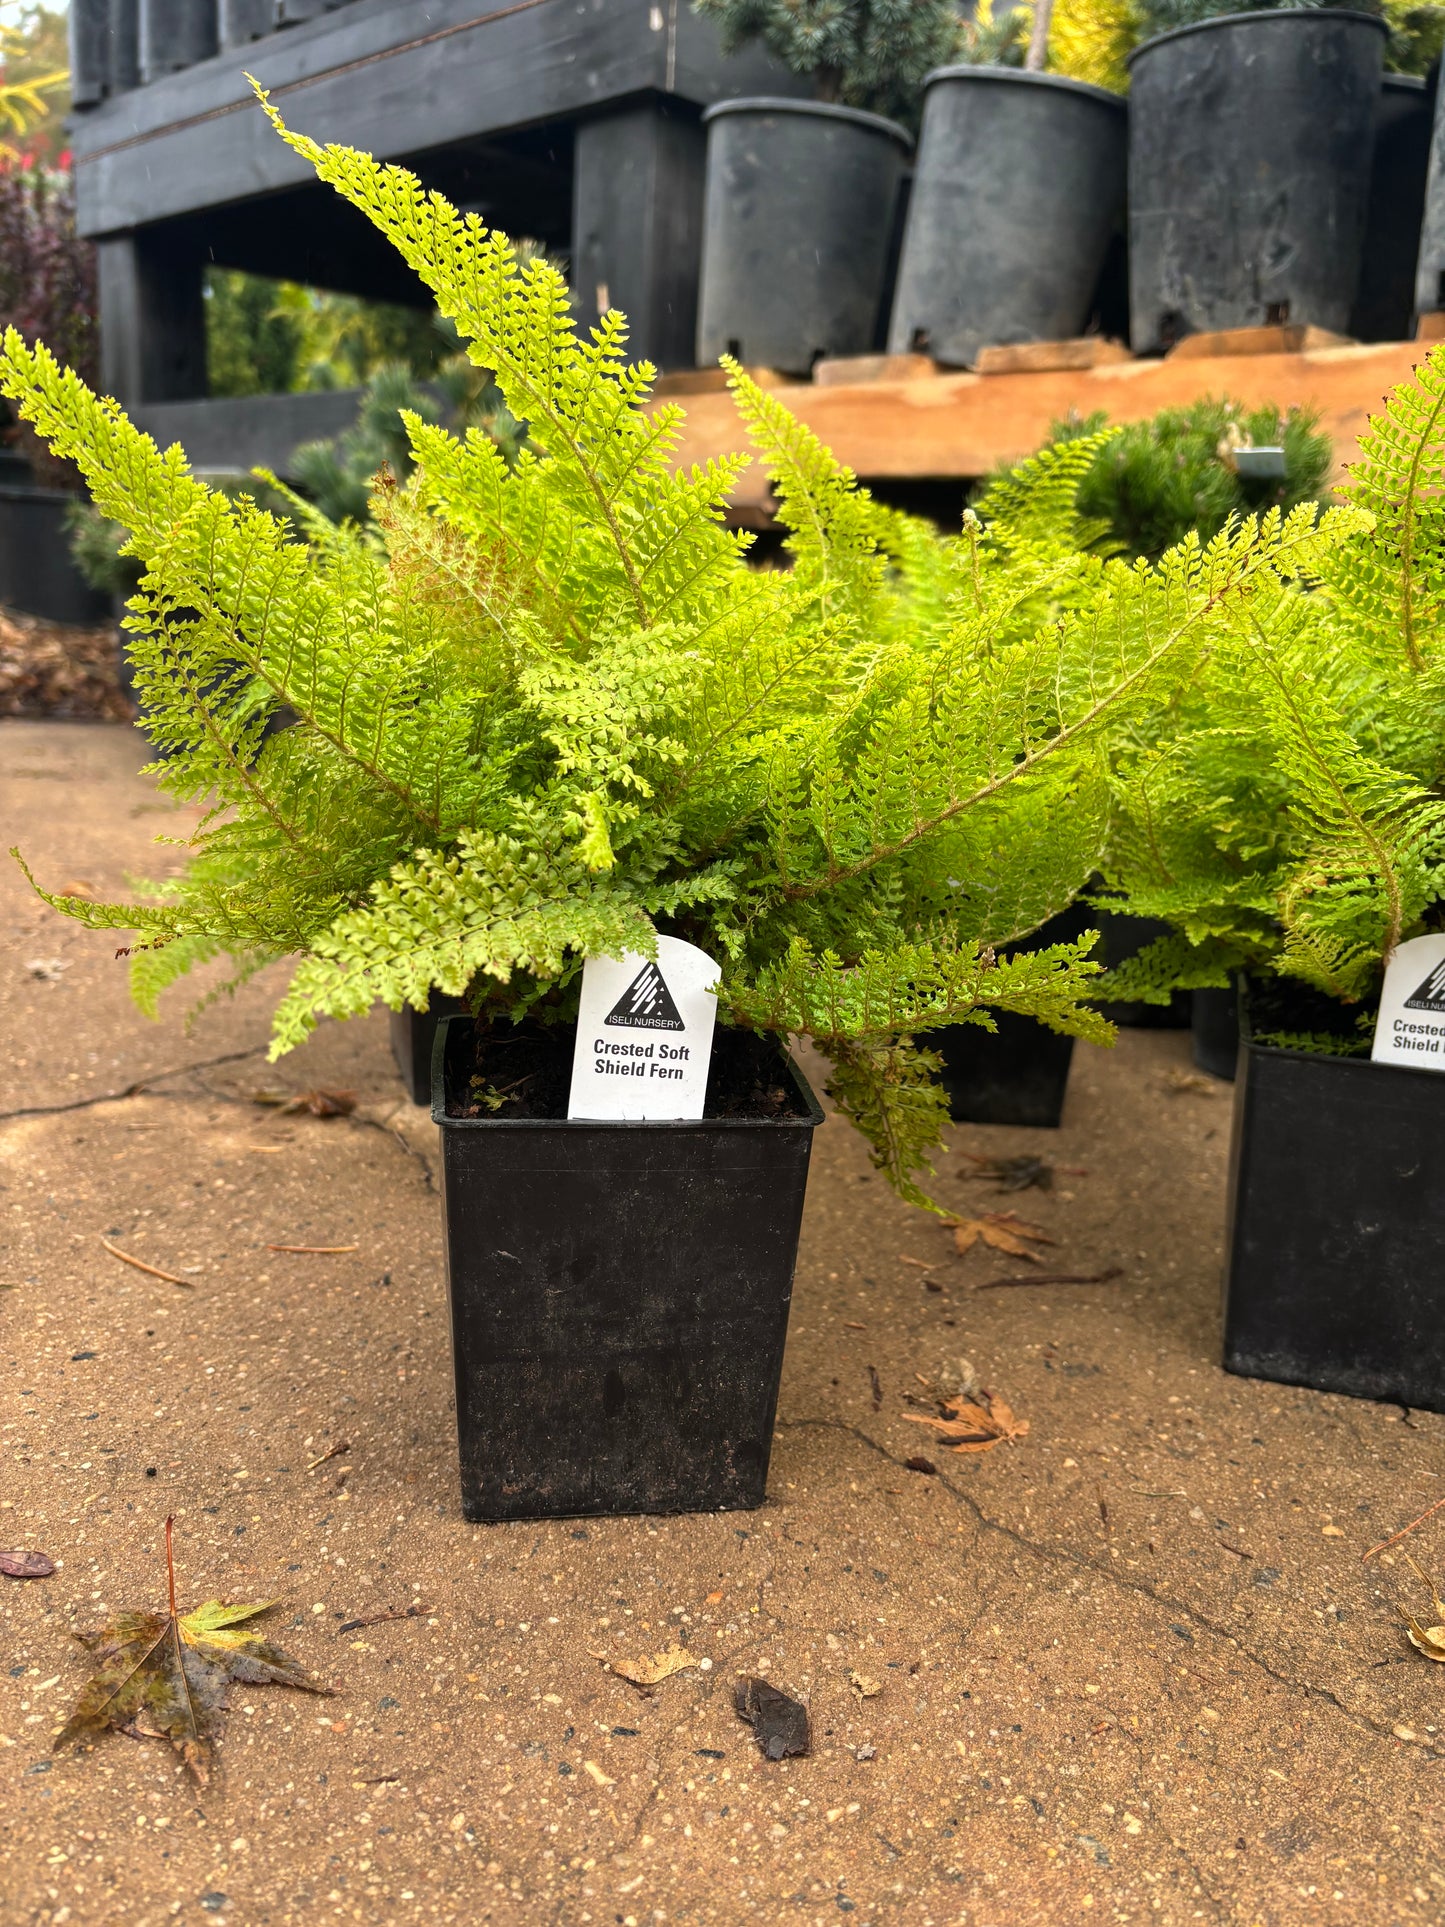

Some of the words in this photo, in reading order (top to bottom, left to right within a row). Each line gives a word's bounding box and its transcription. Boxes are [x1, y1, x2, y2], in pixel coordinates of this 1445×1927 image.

[1408, 1000, 1429, 1009] ISELI
[1430, 1002, 1445, 1010] NU
[608, 1015, 633, 1025] ISELI
[634, 1017, 681, 1029] NURSERY
[594, 1039, 654, 1058] Crested
[659, 1044, 690, 1061] Soft
[1393, 1035, 1439, 1052] Shield
[594, 1059, 645, 1077] Shield
[650, 1063, 683, 1080] Fern
